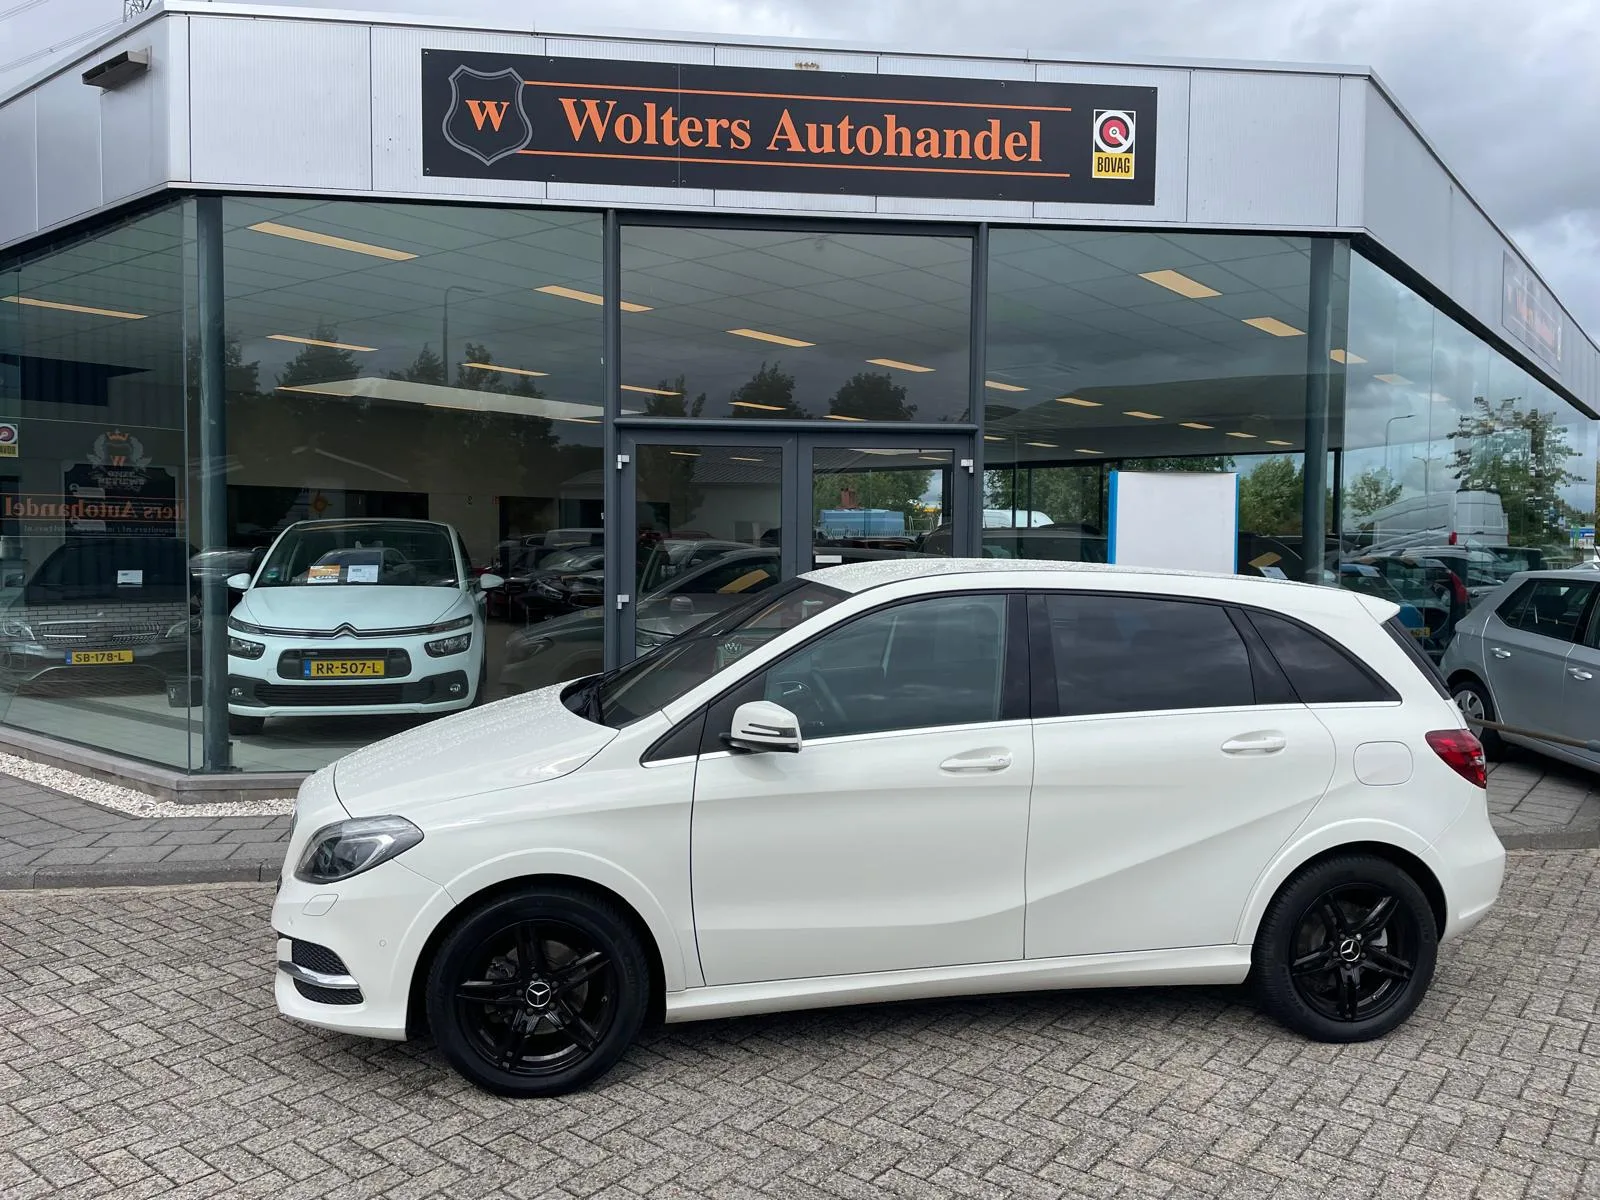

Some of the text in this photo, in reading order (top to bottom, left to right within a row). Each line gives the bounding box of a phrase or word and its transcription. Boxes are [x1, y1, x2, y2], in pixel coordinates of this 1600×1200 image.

[465, 99, 510, 132] W
[558, 97, 1042, 162] Wolters Autohandel
[1096, 156, 1130, 173] BOVAG
[75, 653, 125, 662] SB-178-L
[316, 662, 379, 674] RR-507-L
